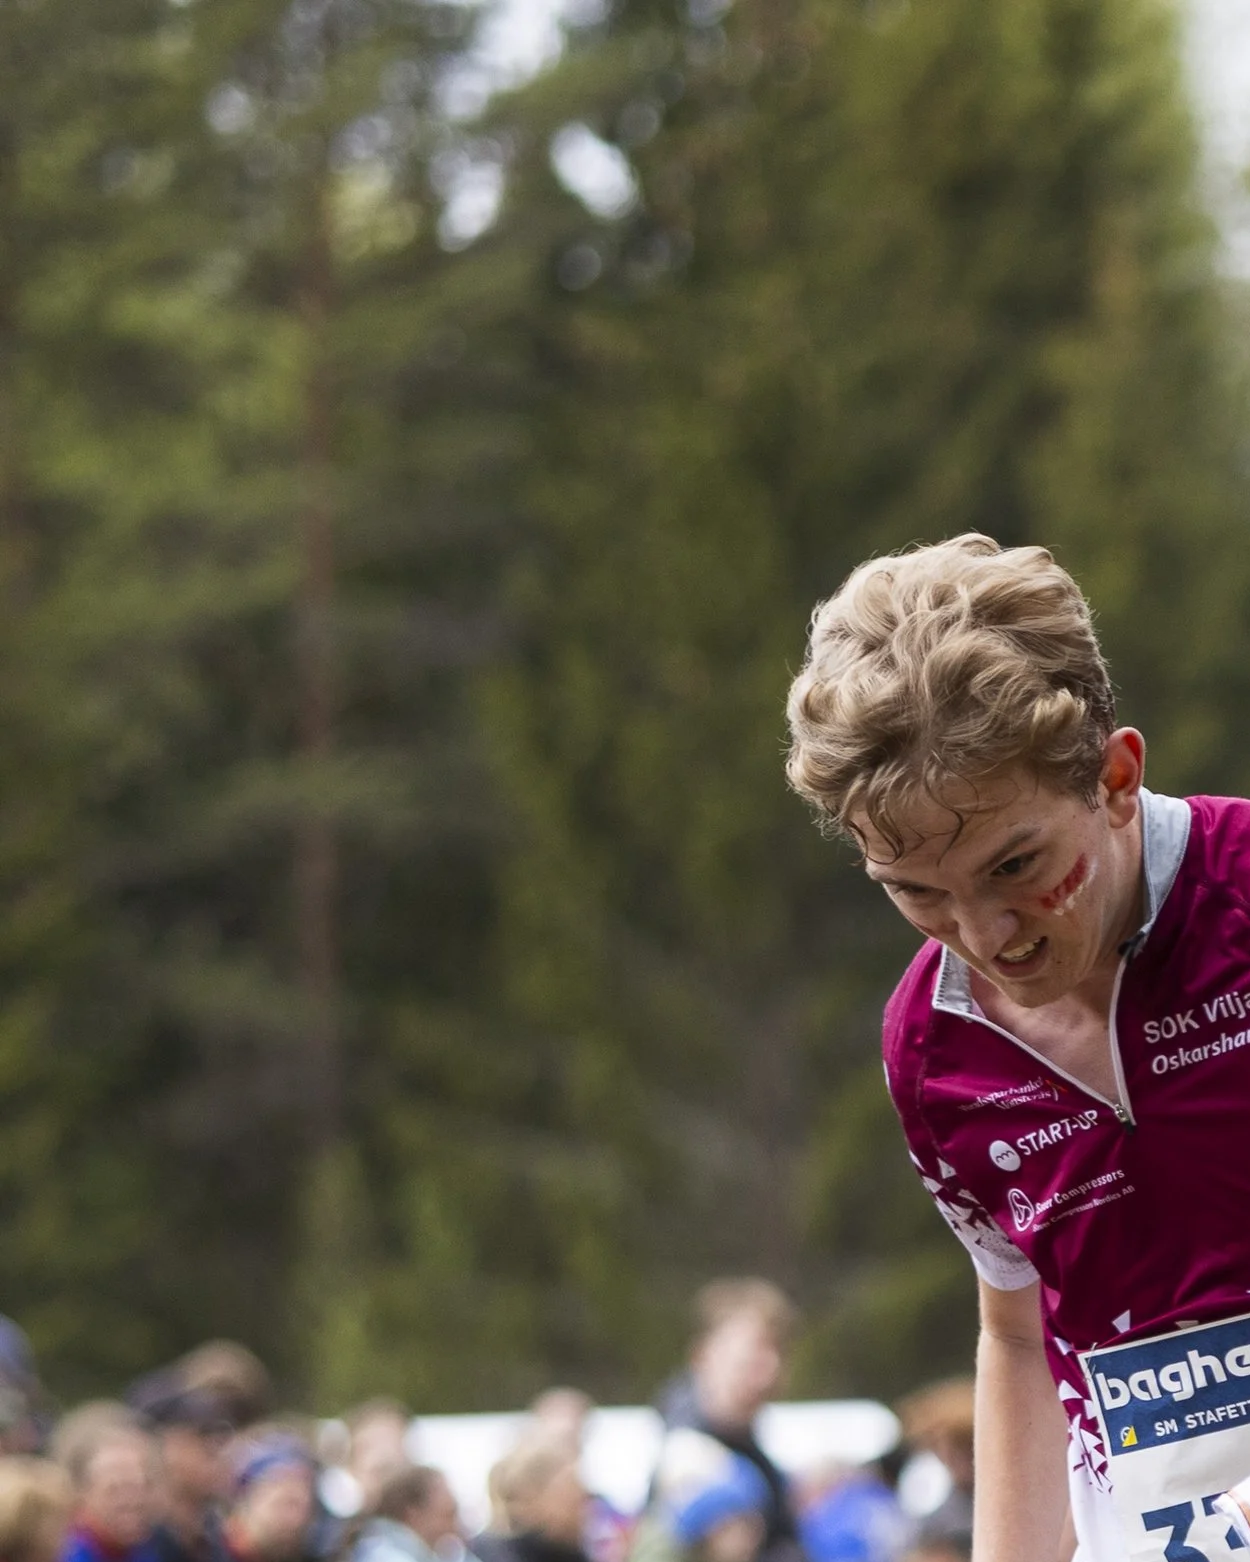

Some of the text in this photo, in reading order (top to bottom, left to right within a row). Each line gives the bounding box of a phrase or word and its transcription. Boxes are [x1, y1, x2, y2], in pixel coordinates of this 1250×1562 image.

[1143, 1008, 1201, 1044] SOK
[1017, 1110, 1098, 1156] START-UP
[1055, 1169, 1126, 1206] Compressors
[1154, 1418, 1179, 1437] SM
